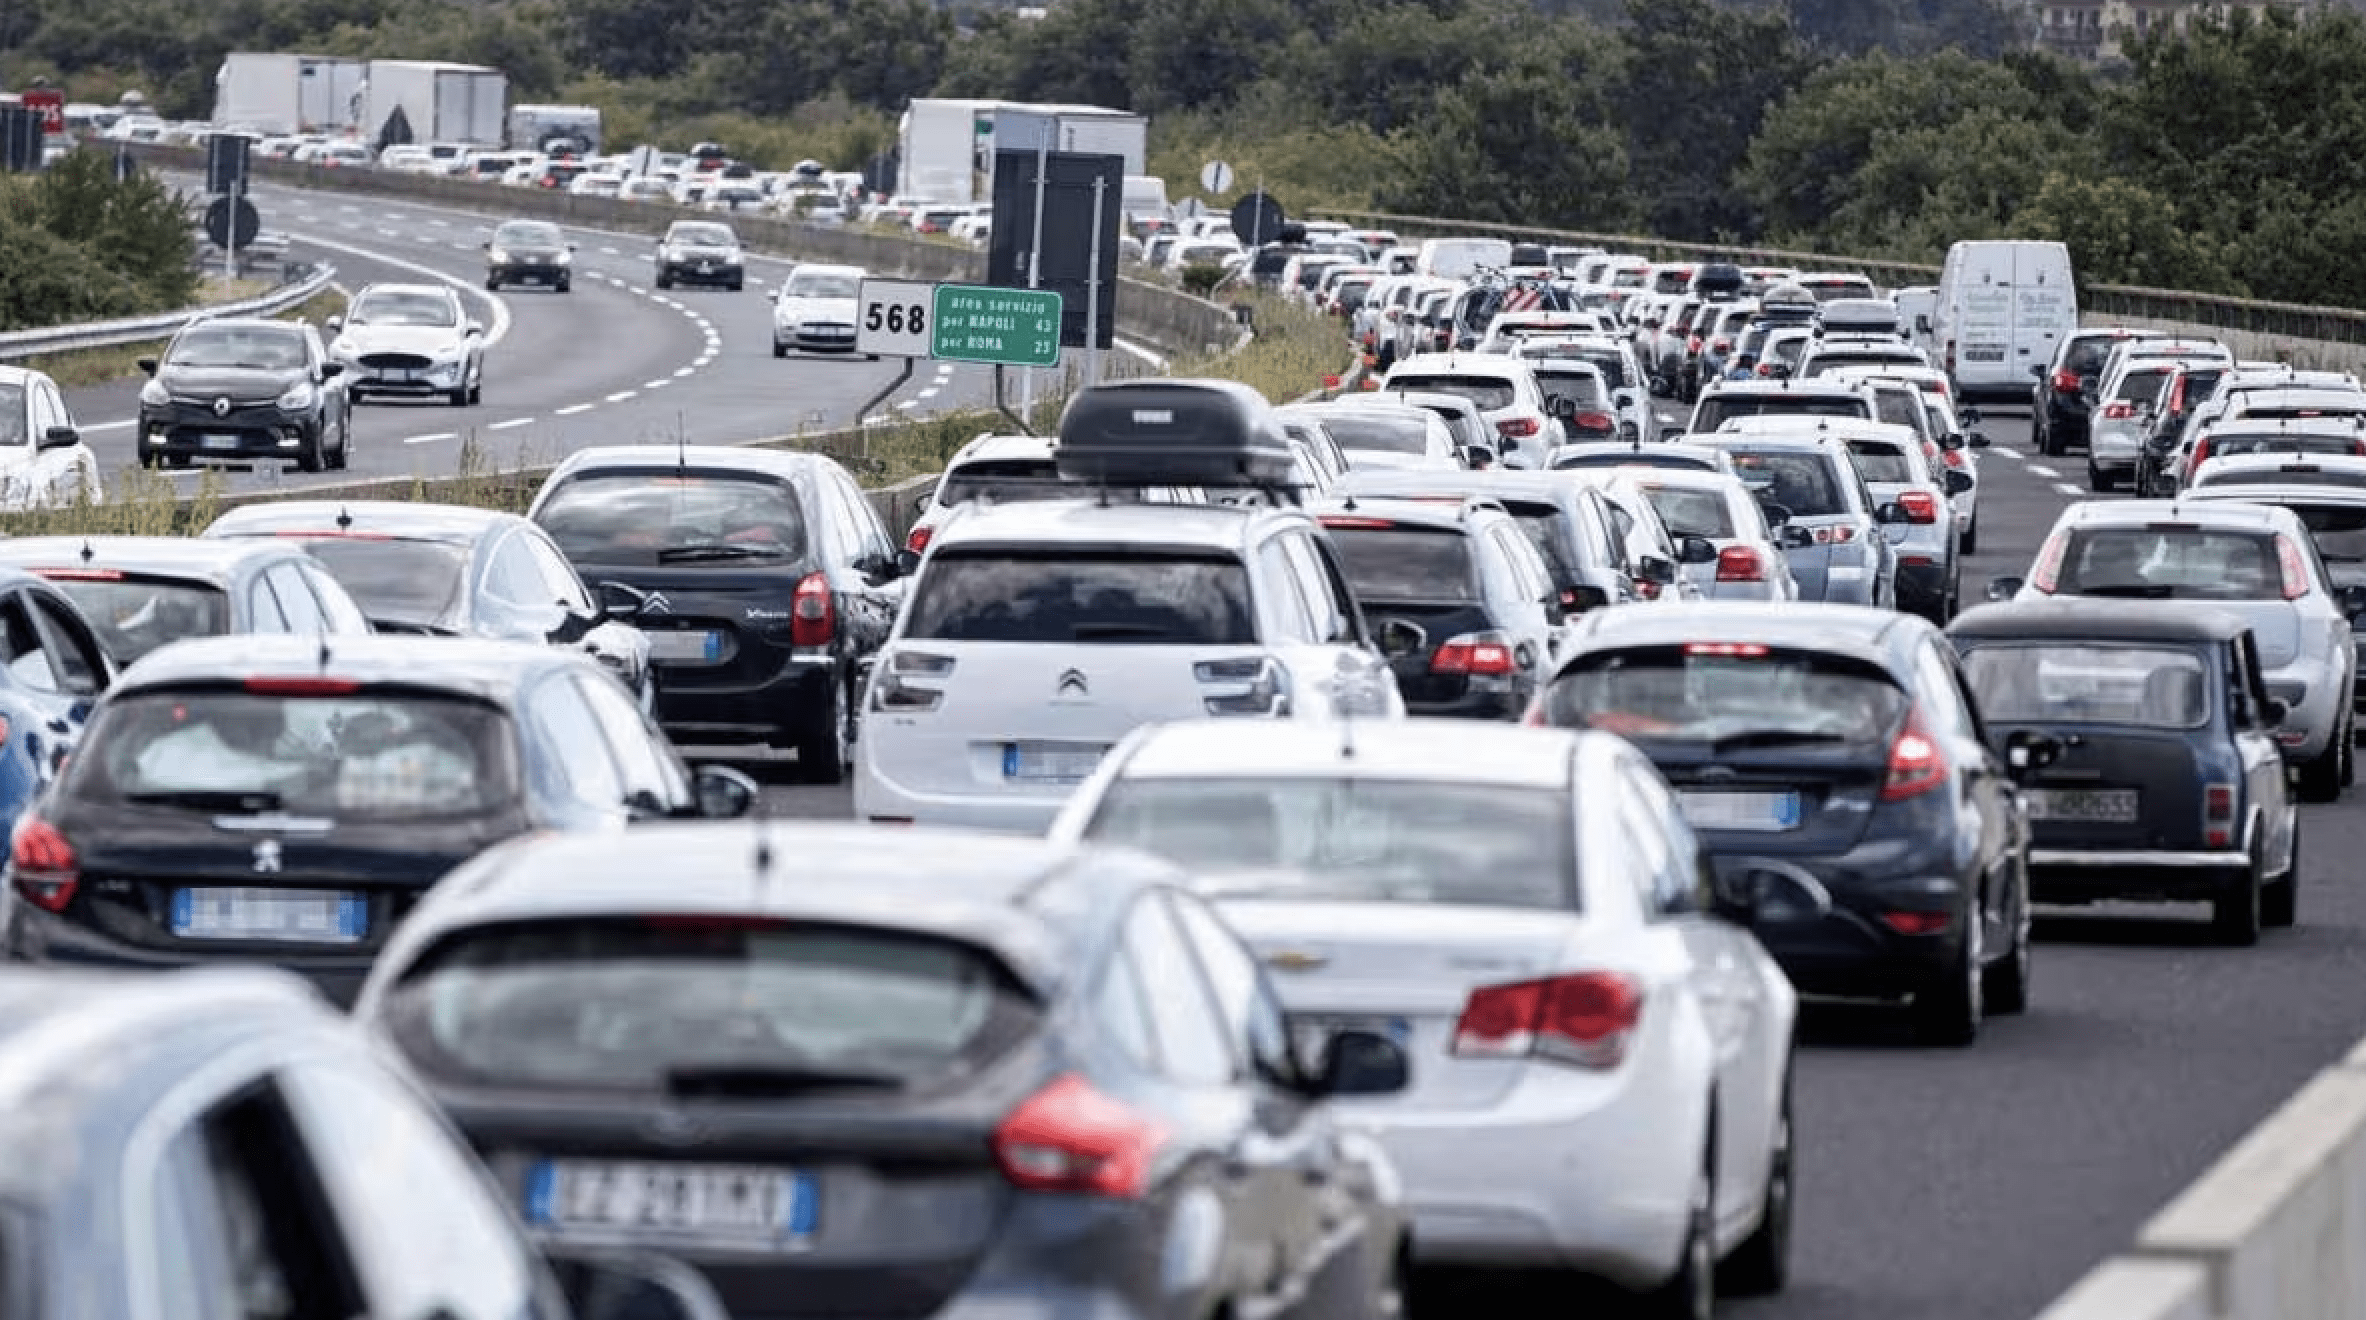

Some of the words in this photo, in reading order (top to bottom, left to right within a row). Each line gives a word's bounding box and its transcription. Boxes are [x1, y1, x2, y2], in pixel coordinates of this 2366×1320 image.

[951, 298, 983, 310] area
[989, 298, 1045, 315] servizio
[865, 301, 925, 335] 568
[941, 315, 964, 329] per
[969, 315, 1015, 331] NAPOLI
[941, 337, 963, 350] per
[967, 336, 1003, 350] ROMA
